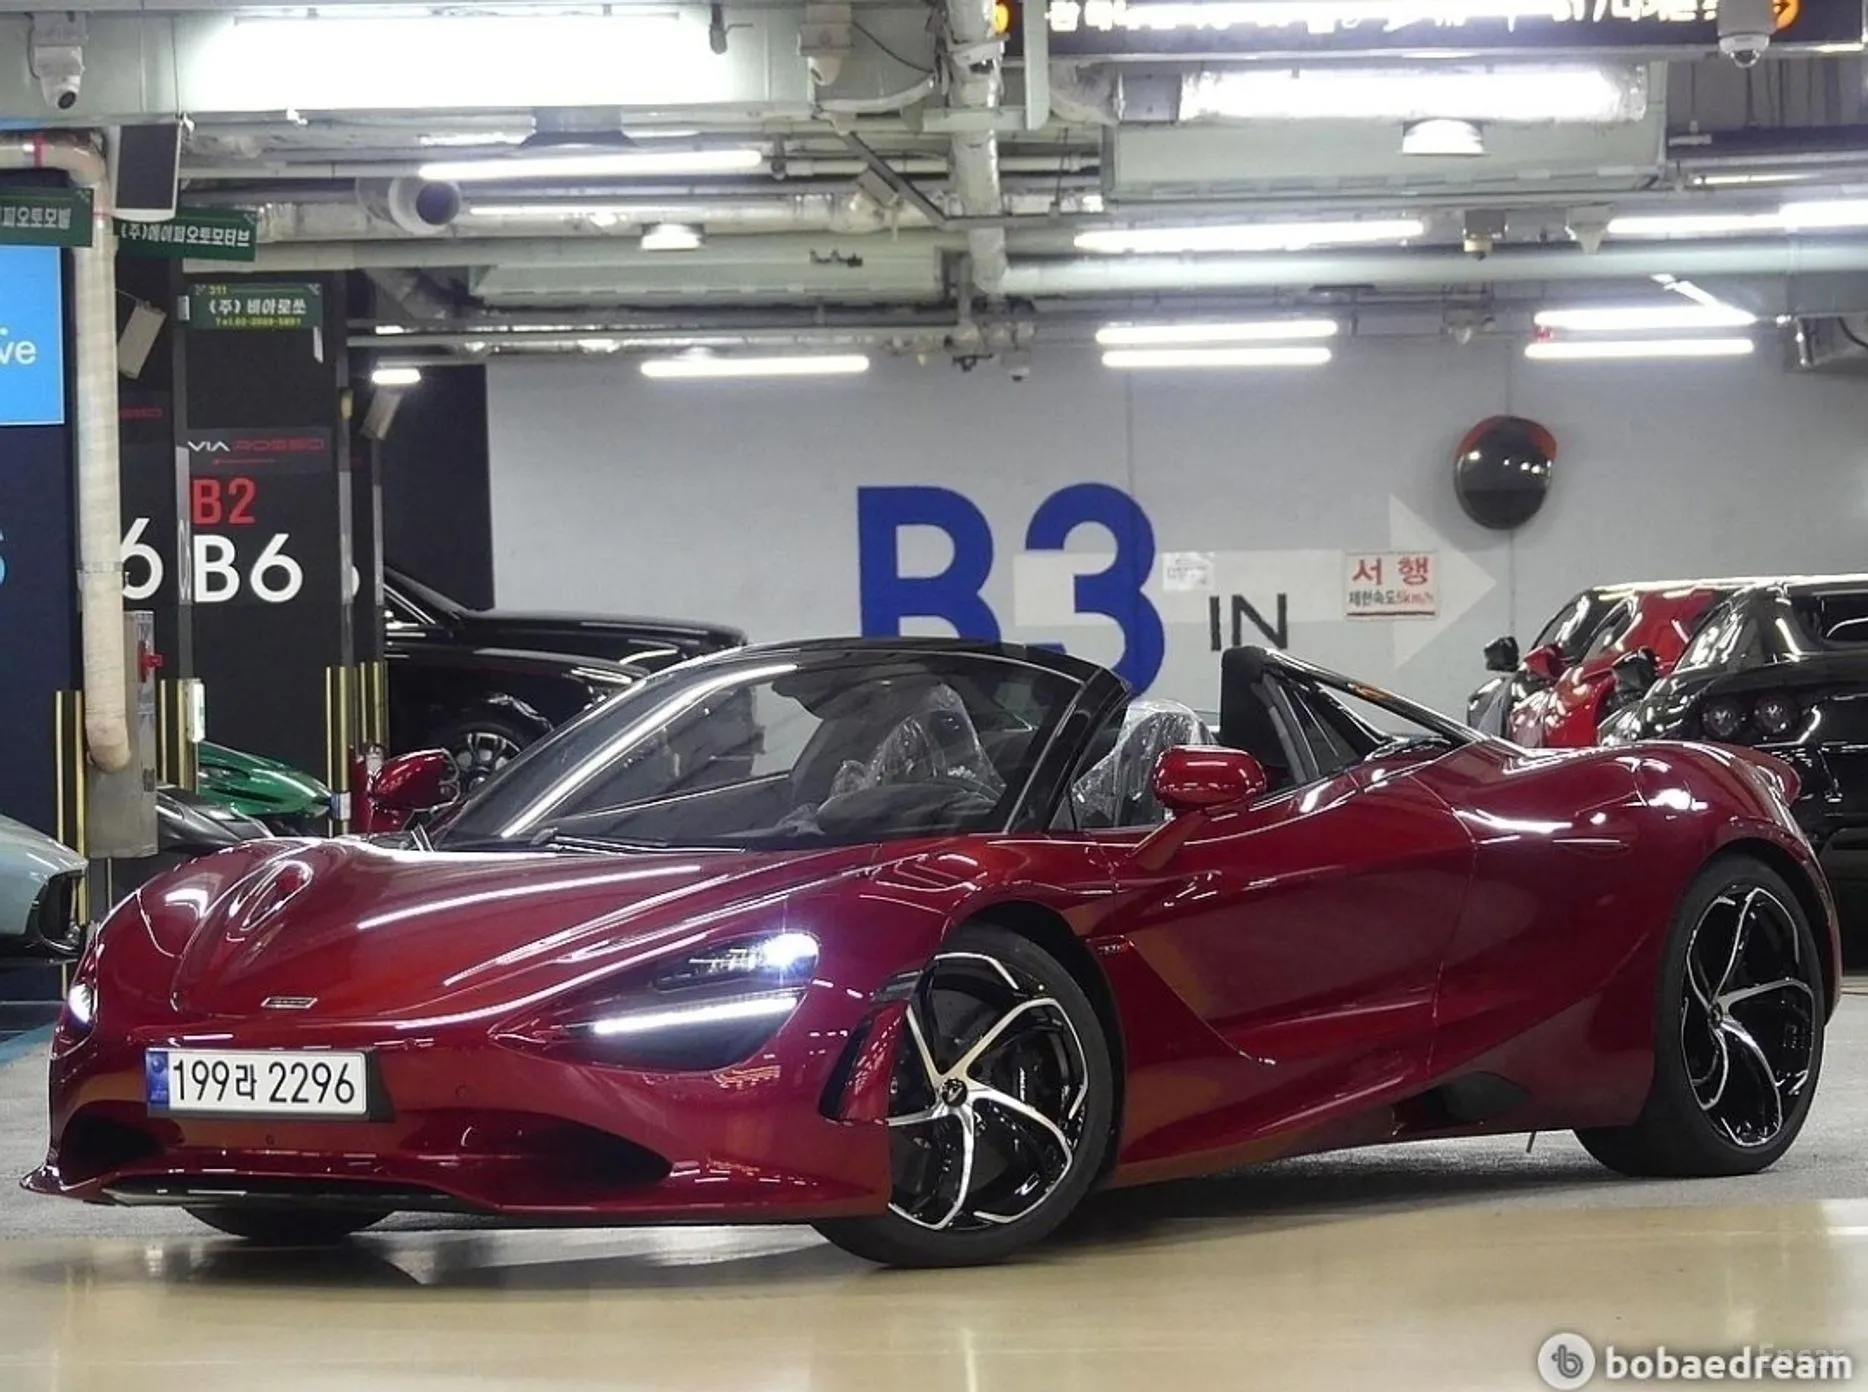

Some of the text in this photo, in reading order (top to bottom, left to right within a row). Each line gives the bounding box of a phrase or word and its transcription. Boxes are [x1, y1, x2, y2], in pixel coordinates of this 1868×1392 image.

[188, 440, 230, 451] VIA
[193, 477, 256, 524] B2
[193, 533, 303, 603] B6
[857, 483, 1165, 700] B3
[1209, 593, 1288, 652] IN
[173, 1060, 355, 1104] 199라 2296
